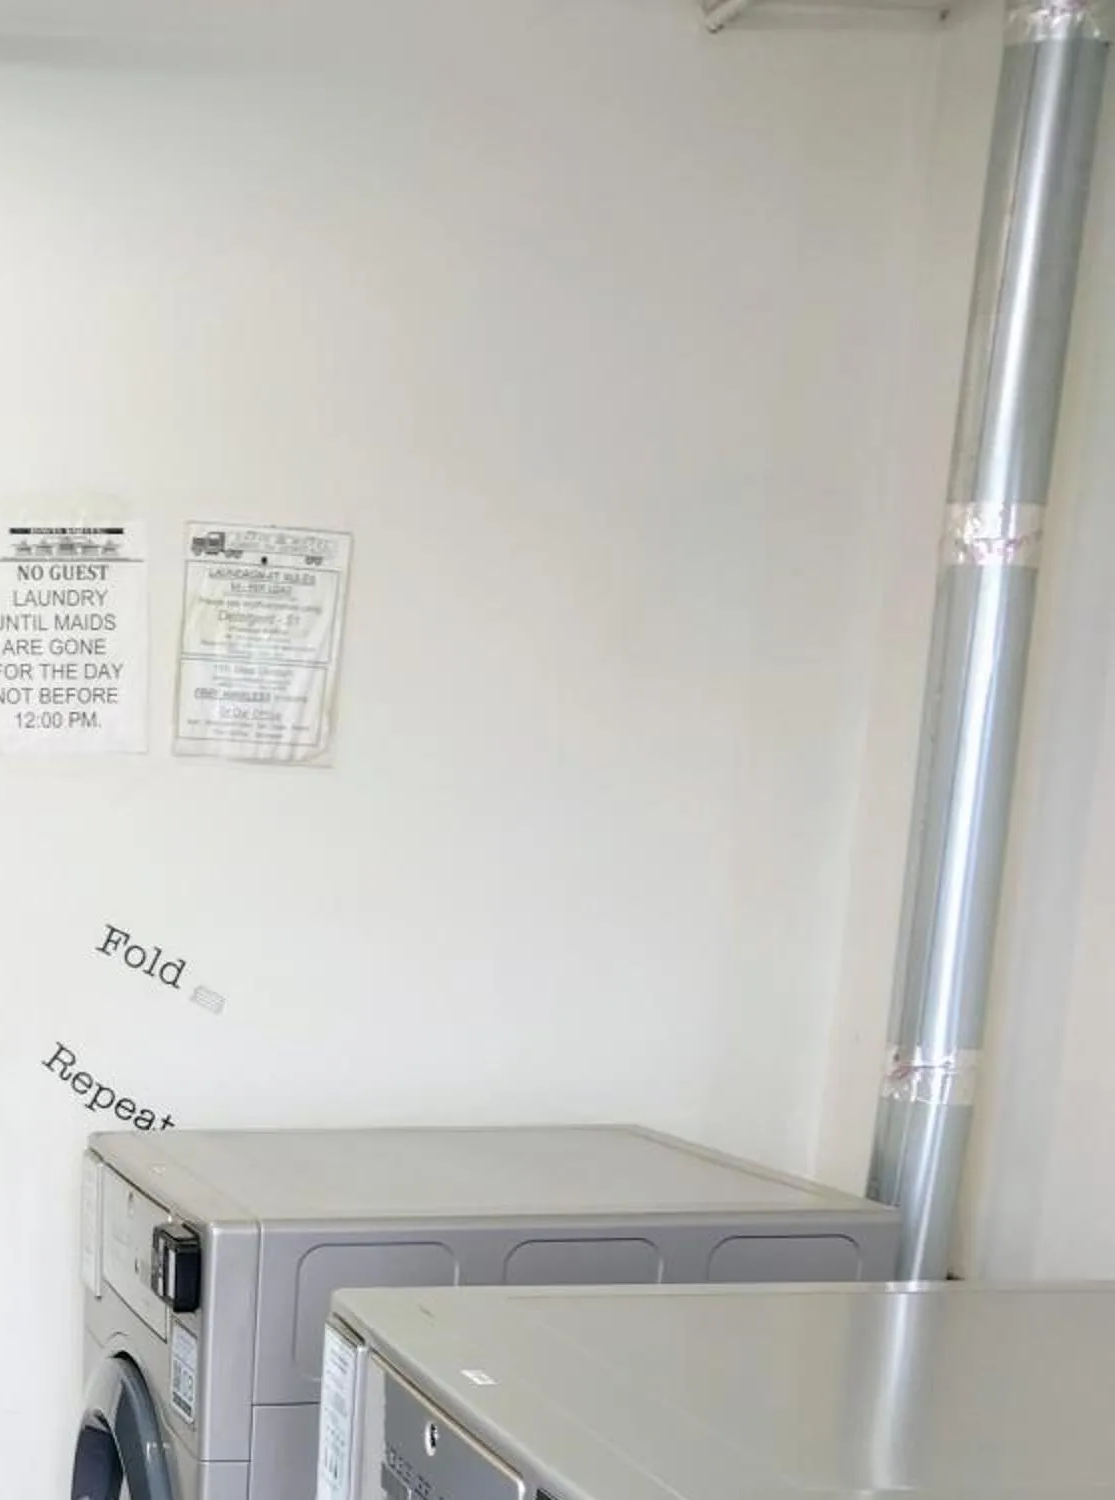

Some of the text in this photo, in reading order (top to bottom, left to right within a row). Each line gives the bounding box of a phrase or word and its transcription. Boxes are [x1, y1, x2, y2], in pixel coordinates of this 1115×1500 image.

[16, 565, 109, 581] NO GUEST
[12, 589, 109, 607] LAUNDRY
[53, 614, 117, 631] MAIDS
[1, 639, 107, 656] ARE GONE
[40, 663, 77, 680] THE
[84, 663, 124, 680] DAY
[38, 687, 118, 705] BEFORE
[15, 711, 63, 729] 12:00
[95, 923, 186, 989] Fold
[41, 1041, 176, 1131] Repeat
